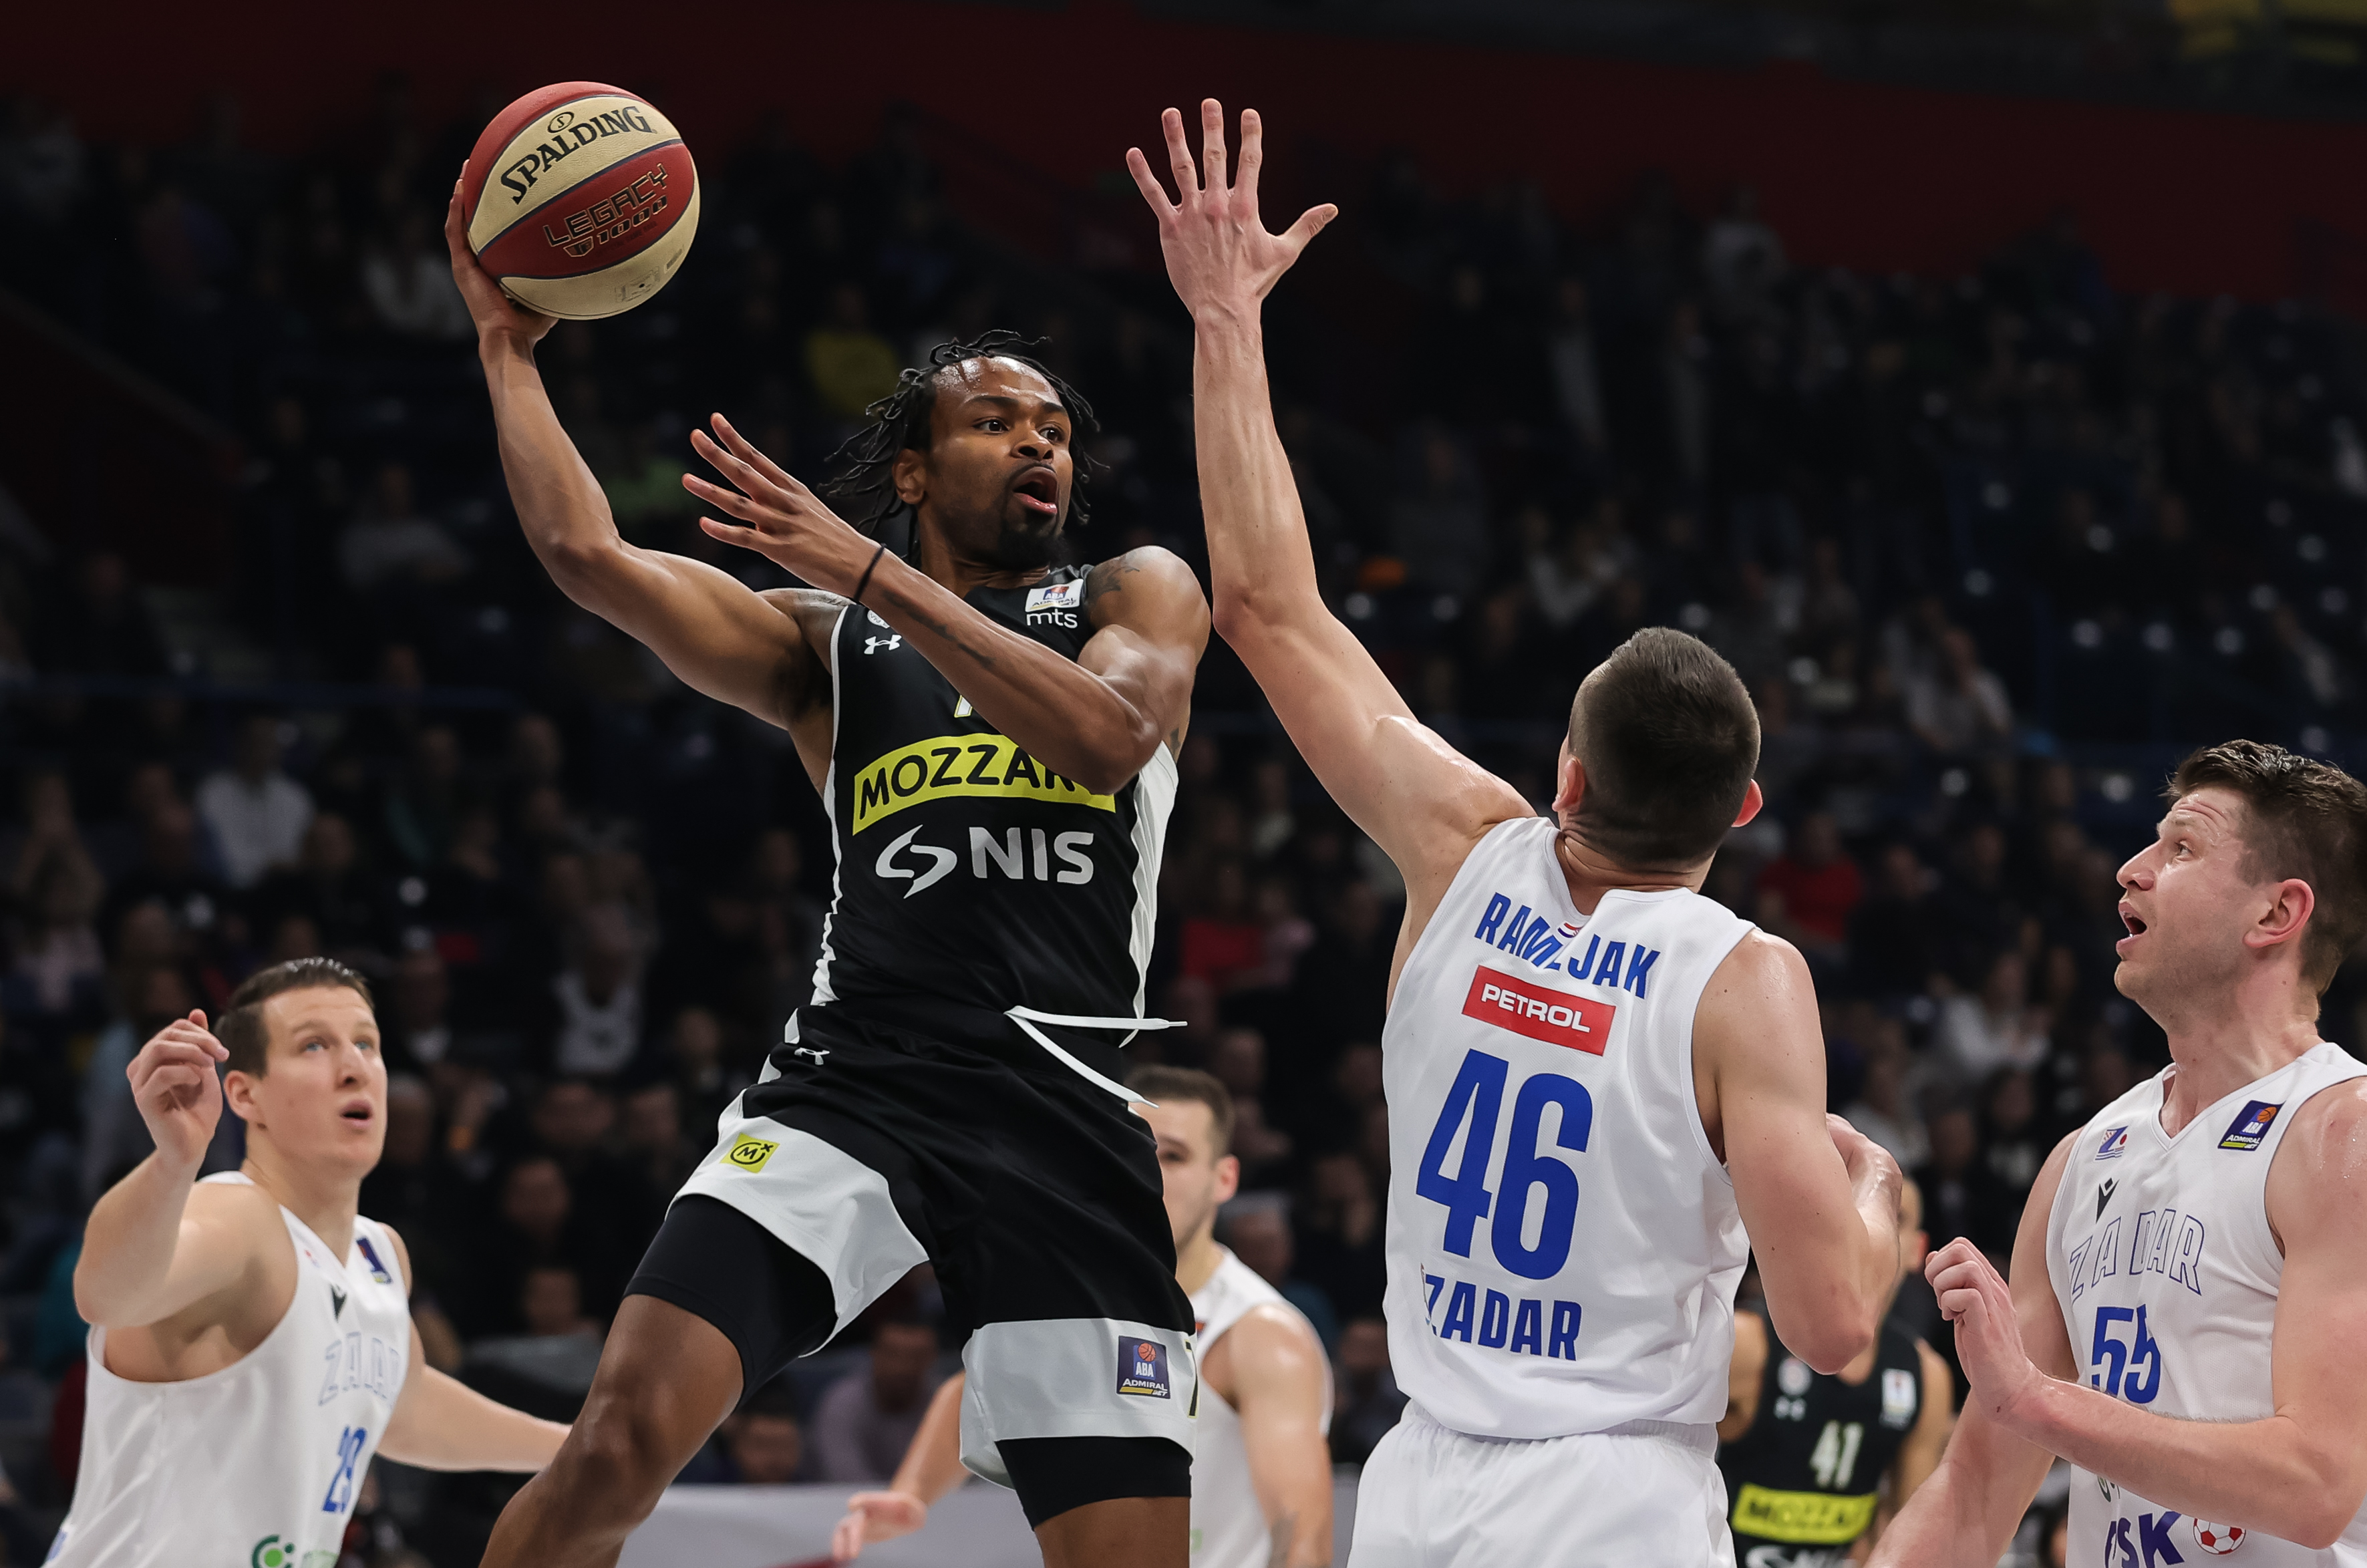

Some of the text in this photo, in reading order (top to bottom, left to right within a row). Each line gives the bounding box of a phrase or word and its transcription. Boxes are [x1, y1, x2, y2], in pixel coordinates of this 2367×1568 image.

[500, 106, 653, 205] SPALDING
[542, 162, 669, 247] LEGACY
[596, 194, 668, 245] 1000
[1026, 608, 1078, 629] mts
[969, 826, 1095, 885] NIS
[1480, 983, 1591, 1034] PETROL
[1416, 1048, 1593, 1281] 46
[2225, 1134, 2261, 1144] ADMIRAL
[2069, 1208, 2205, 1306] ZADAR
[1425, 1273, 1582, 1362] ZADAR
[1122, 1378, 1168, 1392] ADMIRAL
[1135, 1361, 1154, 1378] ABA
[2091, 1303, 2161, 1404] 55
[1809, 1419, 1864, 1491] 41
